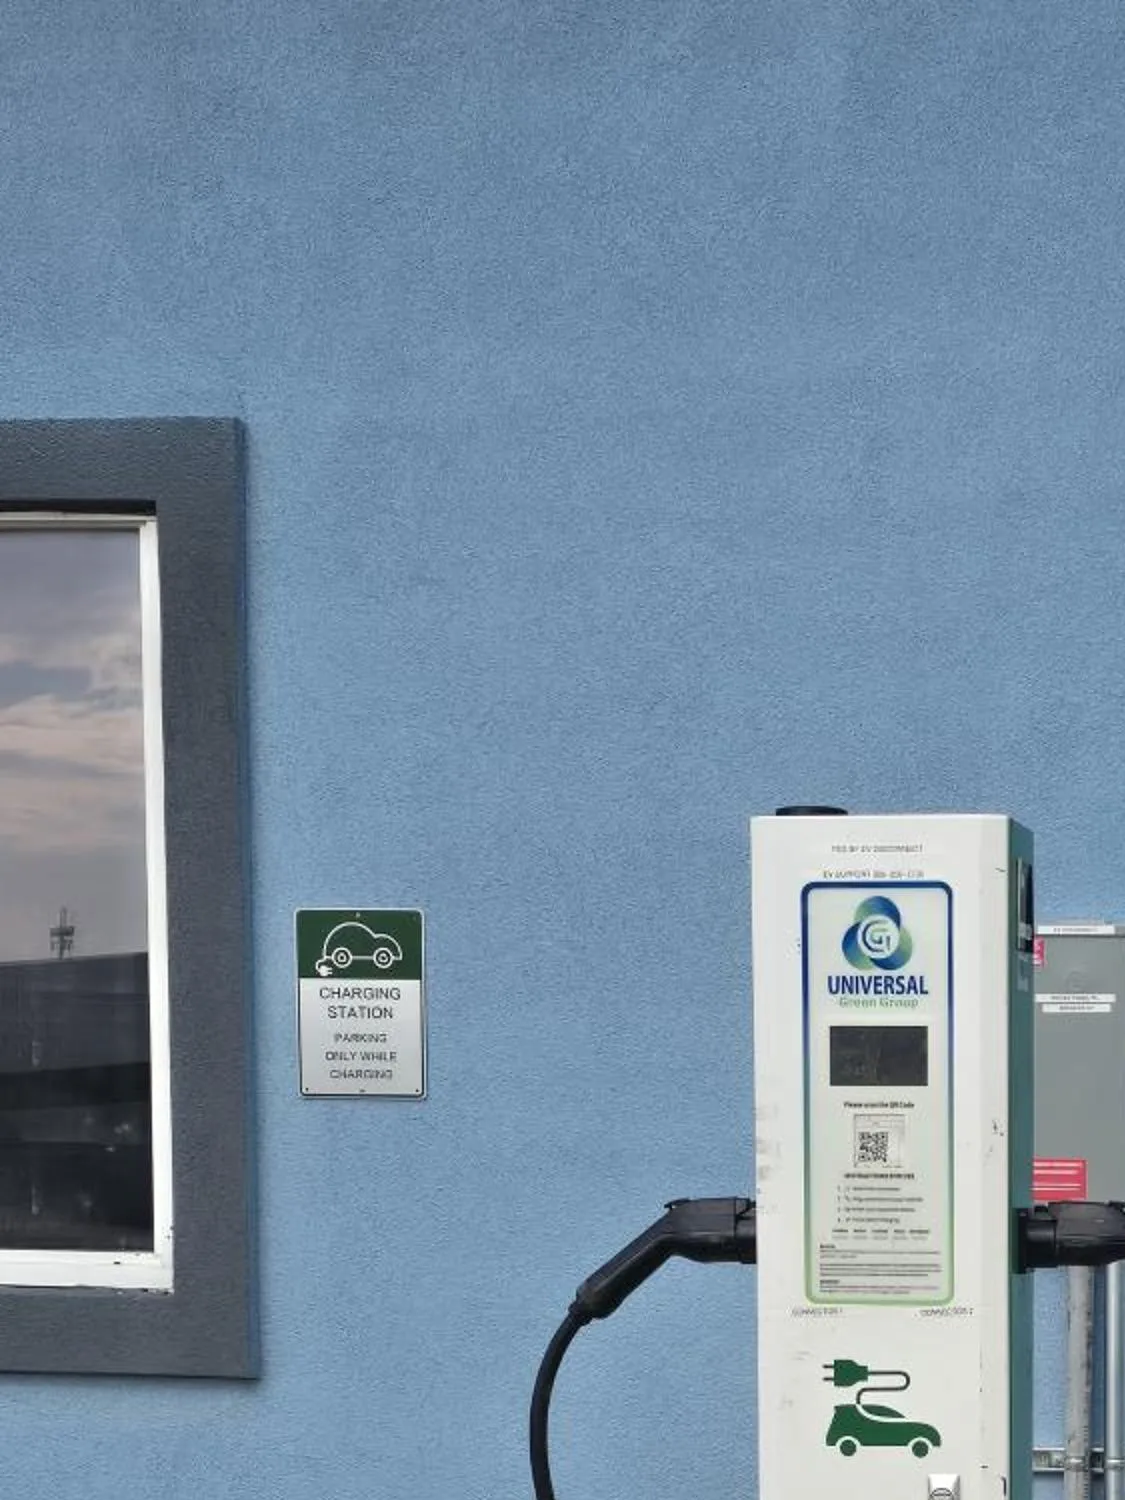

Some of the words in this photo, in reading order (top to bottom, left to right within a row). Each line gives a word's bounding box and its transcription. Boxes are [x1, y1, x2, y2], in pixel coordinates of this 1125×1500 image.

[827, 975, 929, 995] UNIVERSAL
[319, 987, 401, 1001] CHARGING
[839, 996, 877, 1008] Green
[878, 996, 919, 1010] Group
[327, 1005, 394, 1020] STATION
[333, 1033, 388, 1043] PARKING
[325, 1051, 357, 1062] ONLY
[360, 1051, 398, 1062] WHILE
[329, 1069, 393, 1080] CHARGING
